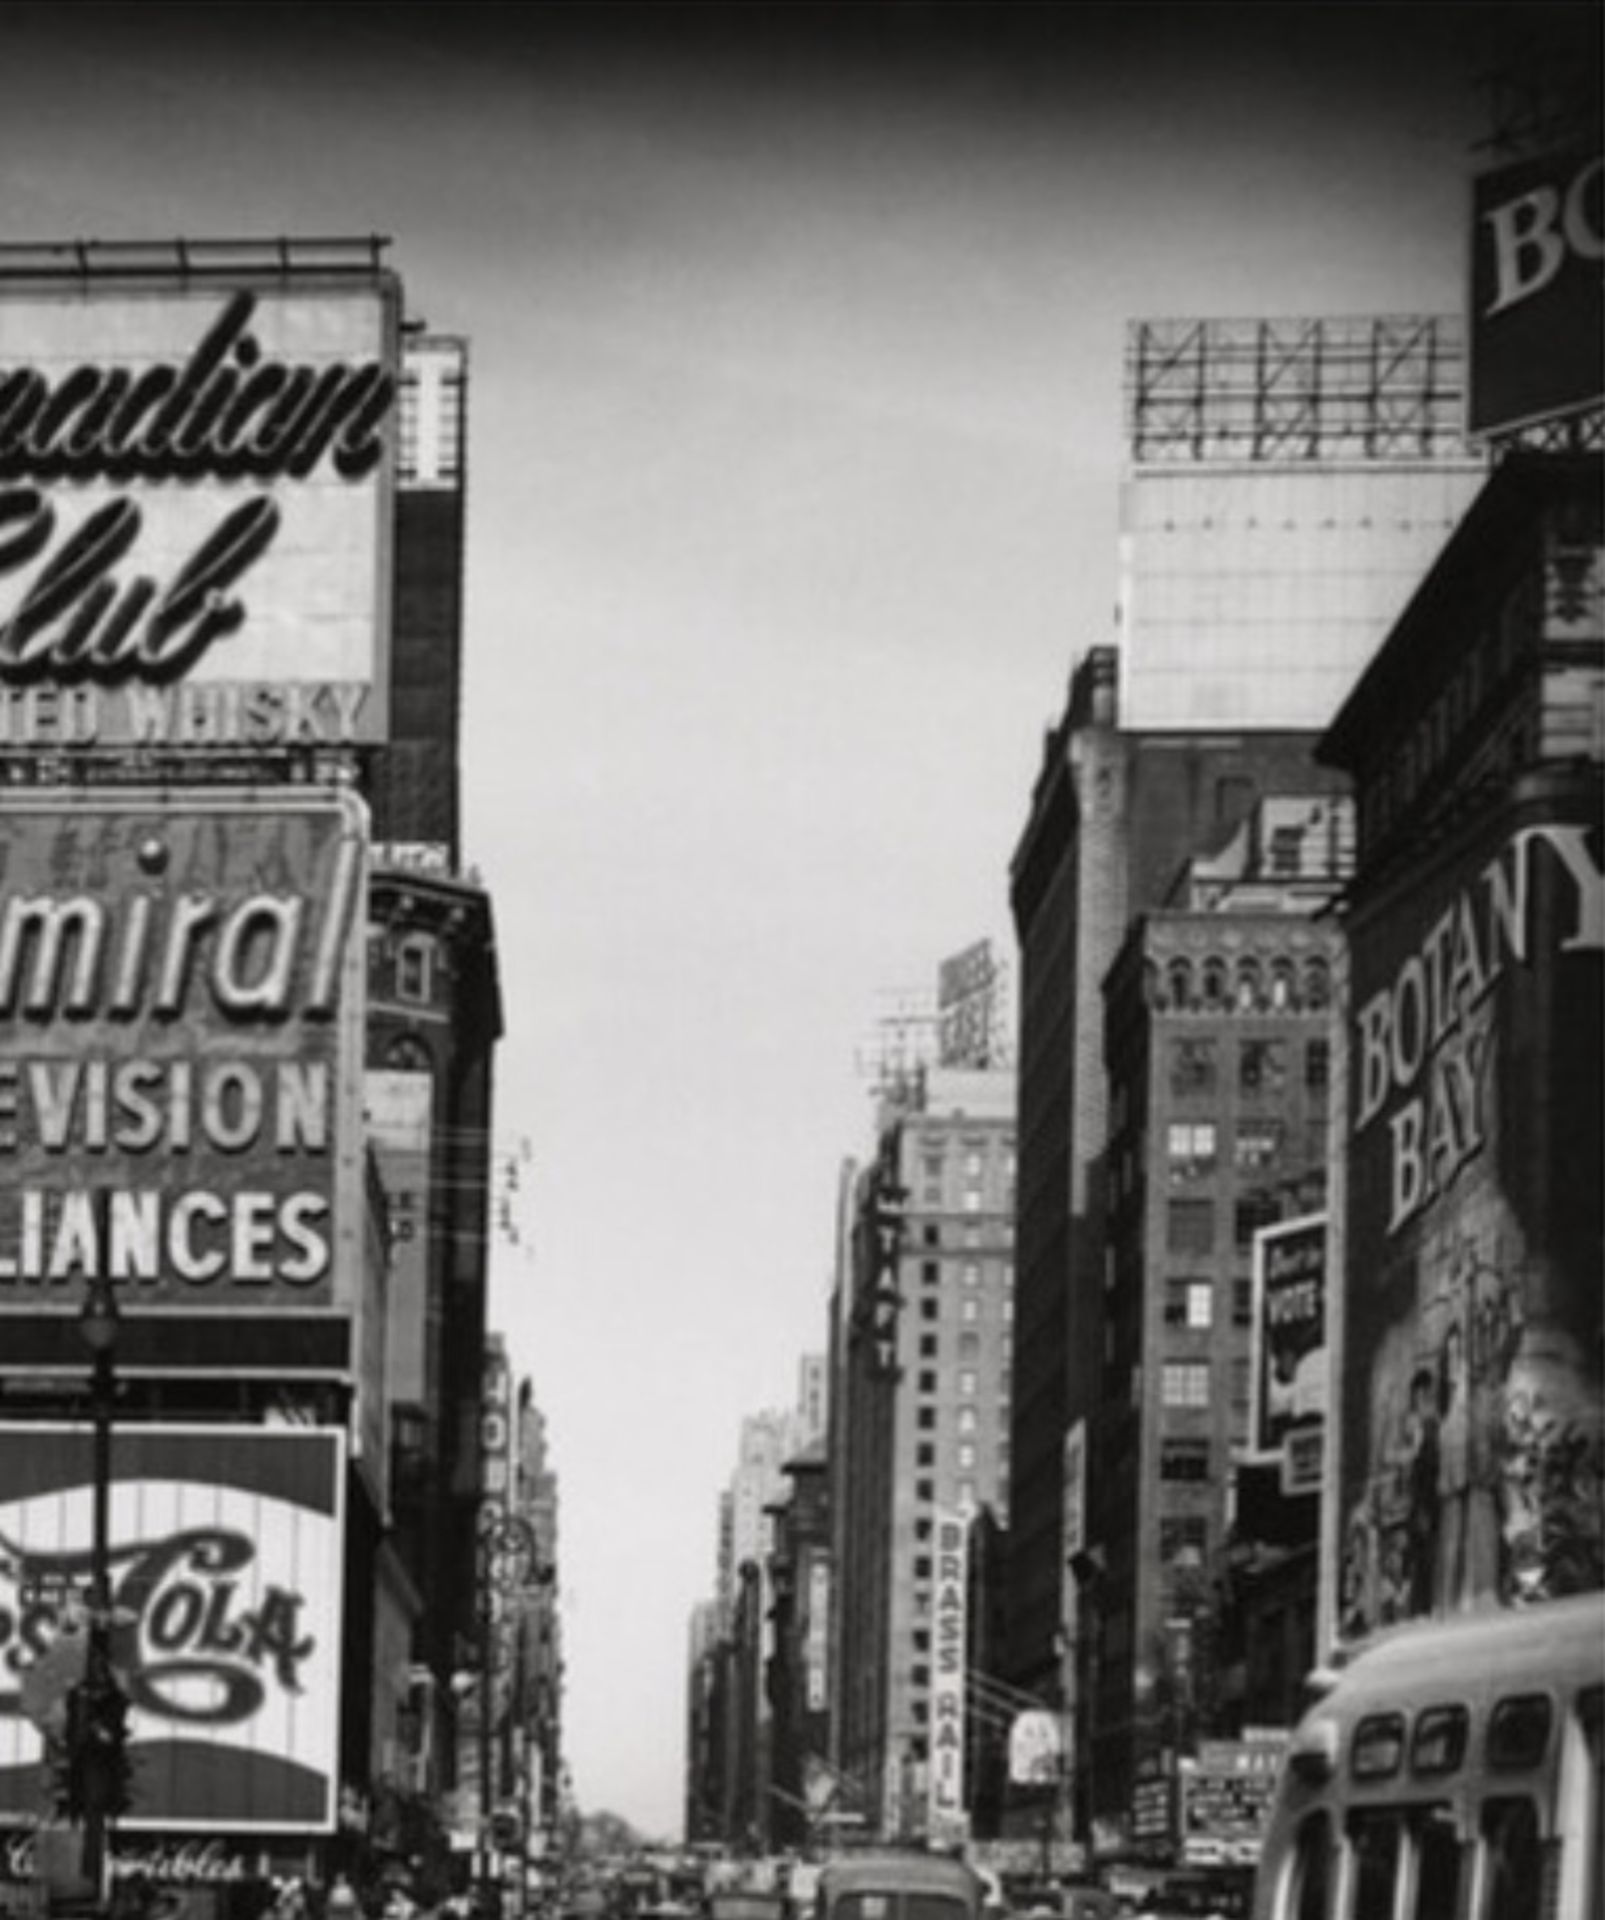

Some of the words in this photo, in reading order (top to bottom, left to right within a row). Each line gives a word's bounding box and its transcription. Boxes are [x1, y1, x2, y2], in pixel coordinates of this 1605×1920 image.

[127, 684, 372, 743] WHISKY
[1386, 1022, 1497, 1236] BAY
[939, 1522, 963, 1675] BRASS
[937, 1689, 961, 1808] RAIL
